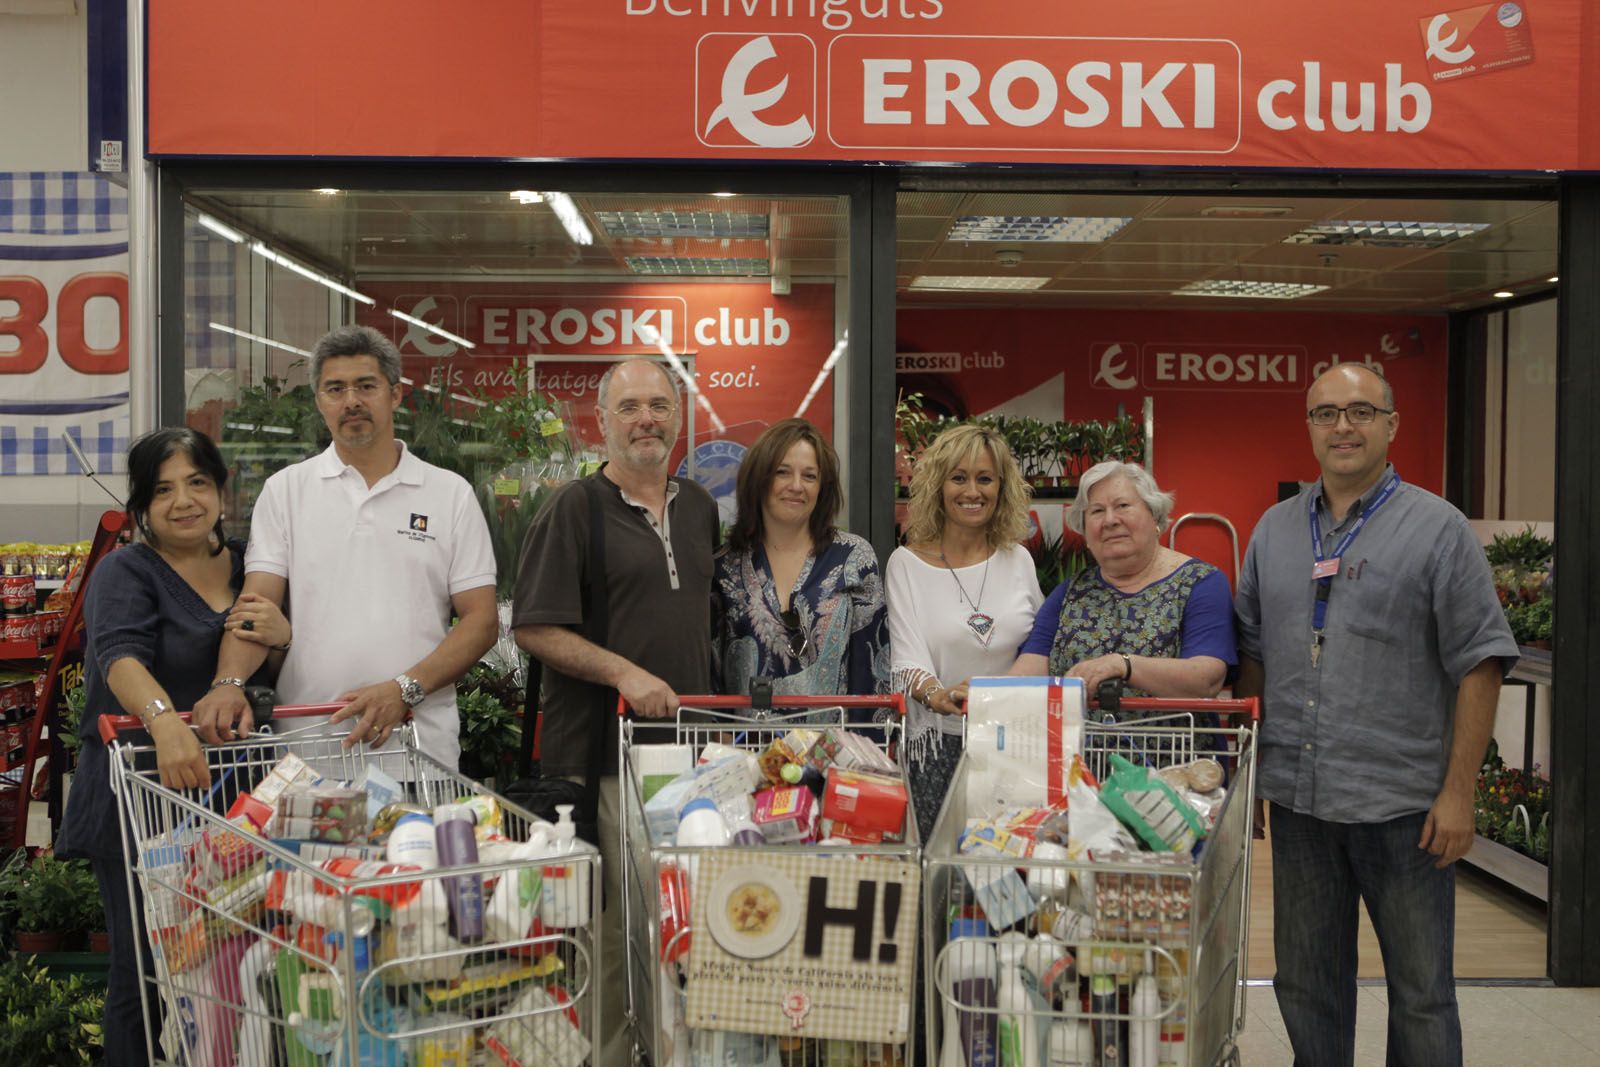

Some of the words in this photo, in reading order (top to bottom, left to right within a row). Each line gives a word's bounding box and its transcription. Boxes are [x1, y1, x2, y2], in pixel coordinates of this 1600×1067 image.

[862, 58, 1216, 128] EROSKI
[1257, 61, 1432, 133] club
[483, 307, 673, 345] EROSKI
[694, 307, 791, 346] club
[896, 356, 956, 369] EROSKI
[963, 351, 1005, 368] club
[1156, 352, 1297, 383] EROSKI
[429, 363, 463, 387] Els
[474, 369, 601, 397] avatatge
[708, 365, 760, 388] soci.
